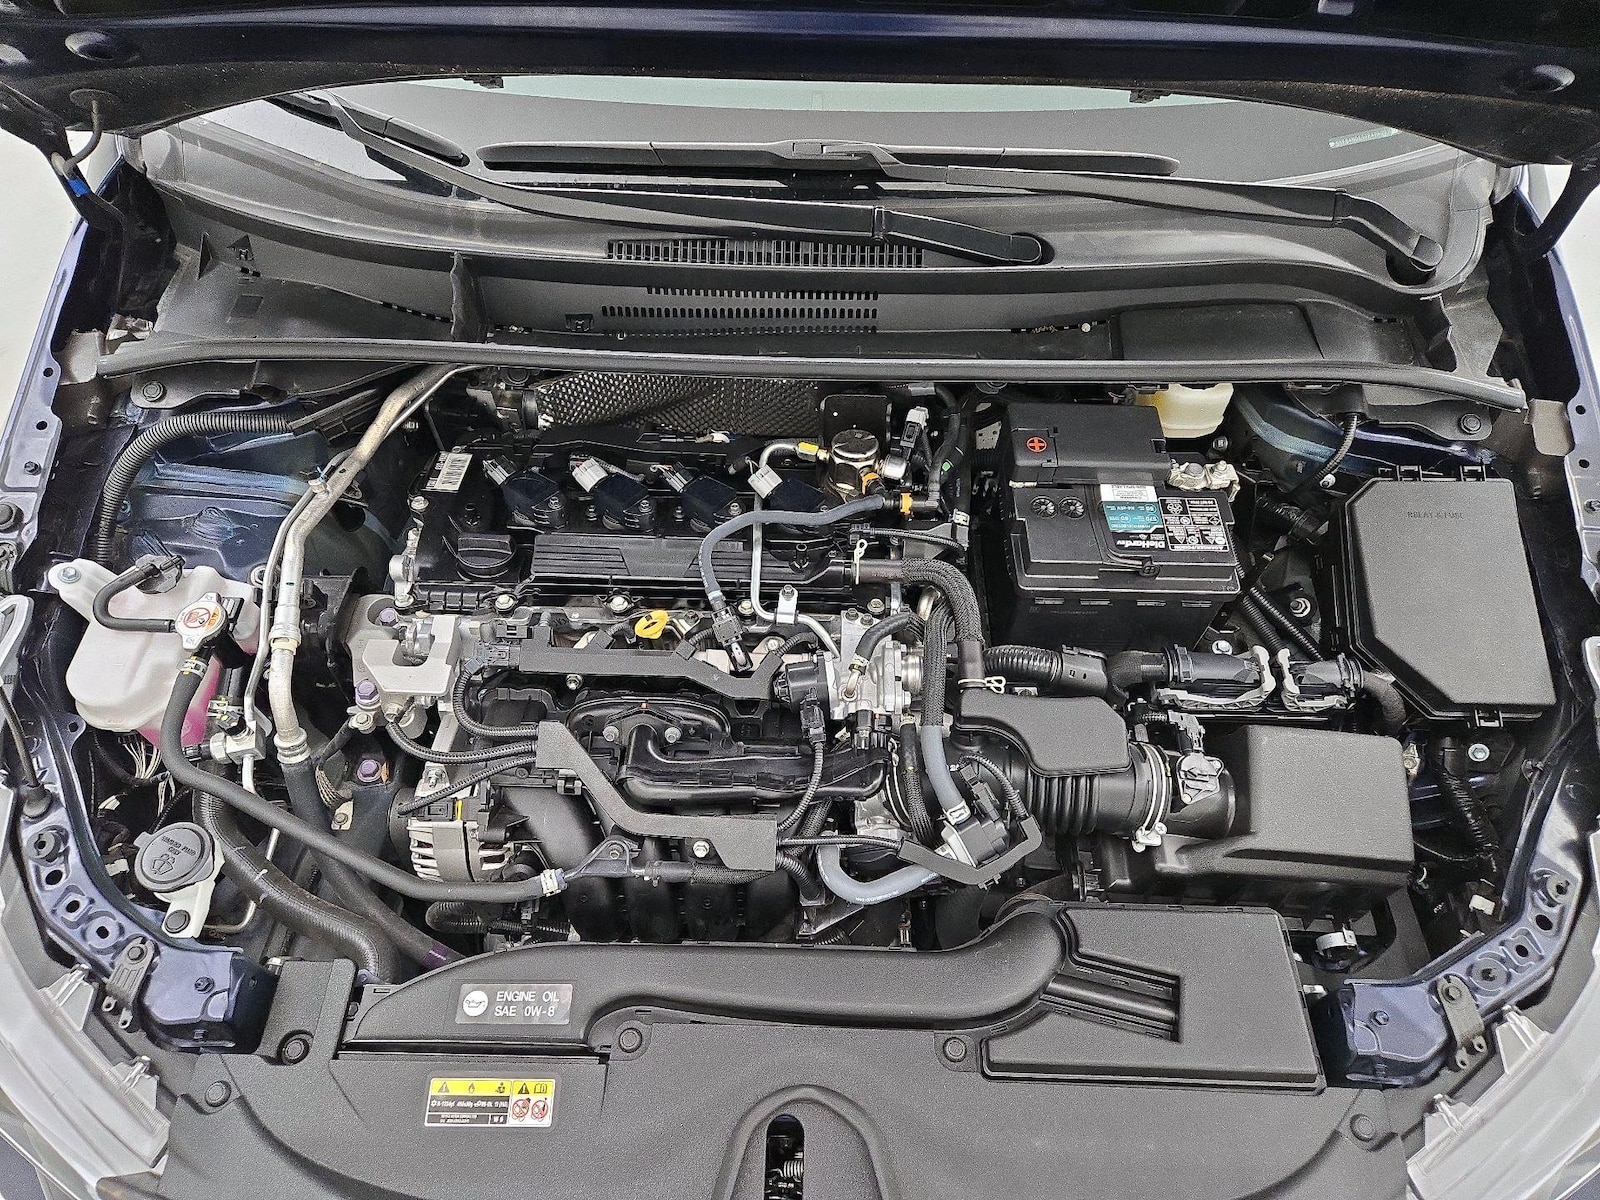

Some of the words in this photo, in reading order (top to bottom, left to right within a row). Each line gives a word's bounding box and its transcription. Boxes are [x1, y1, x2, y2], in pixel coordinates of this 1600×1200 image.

[496, 990, 537, 1002] ENGINE
[542, 990, 560, 1002] OIL
[494, 1005, 518, 1017] SAE
[524, 1005, 555, 1017] 0W-8
